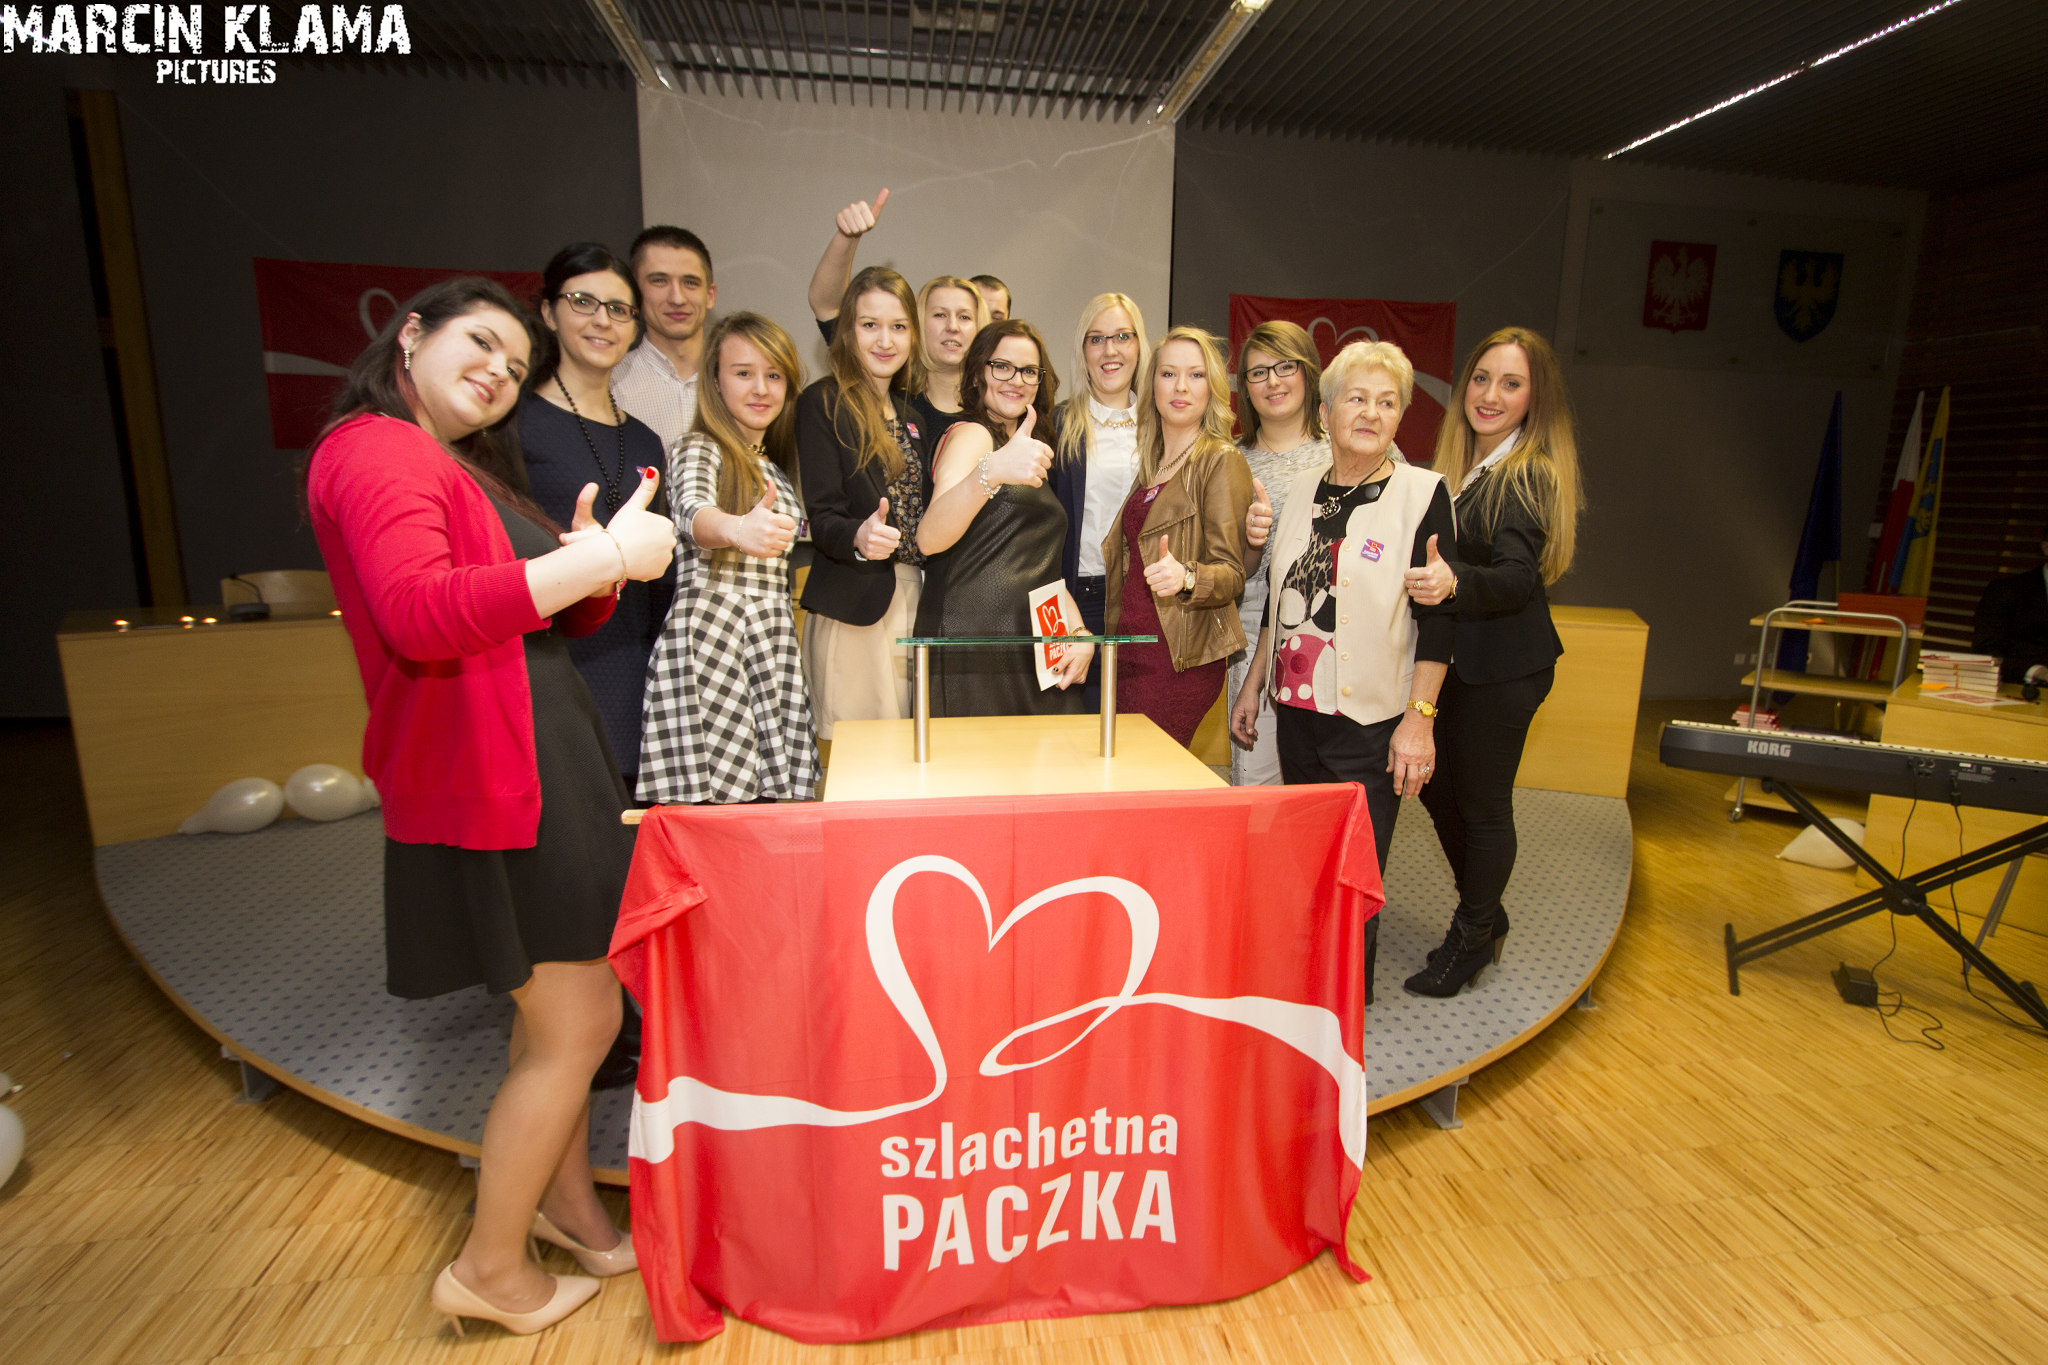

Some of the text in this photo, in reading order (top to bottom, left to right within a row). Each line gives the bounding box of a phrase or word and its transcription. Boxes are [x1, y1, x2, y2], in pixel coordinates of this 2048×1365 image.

[1747, 740, 1791, 757] KORG
[880, 1107, 1178, 1179] szlachetna
[882, 1169, 1177, 1272] PACZKA
